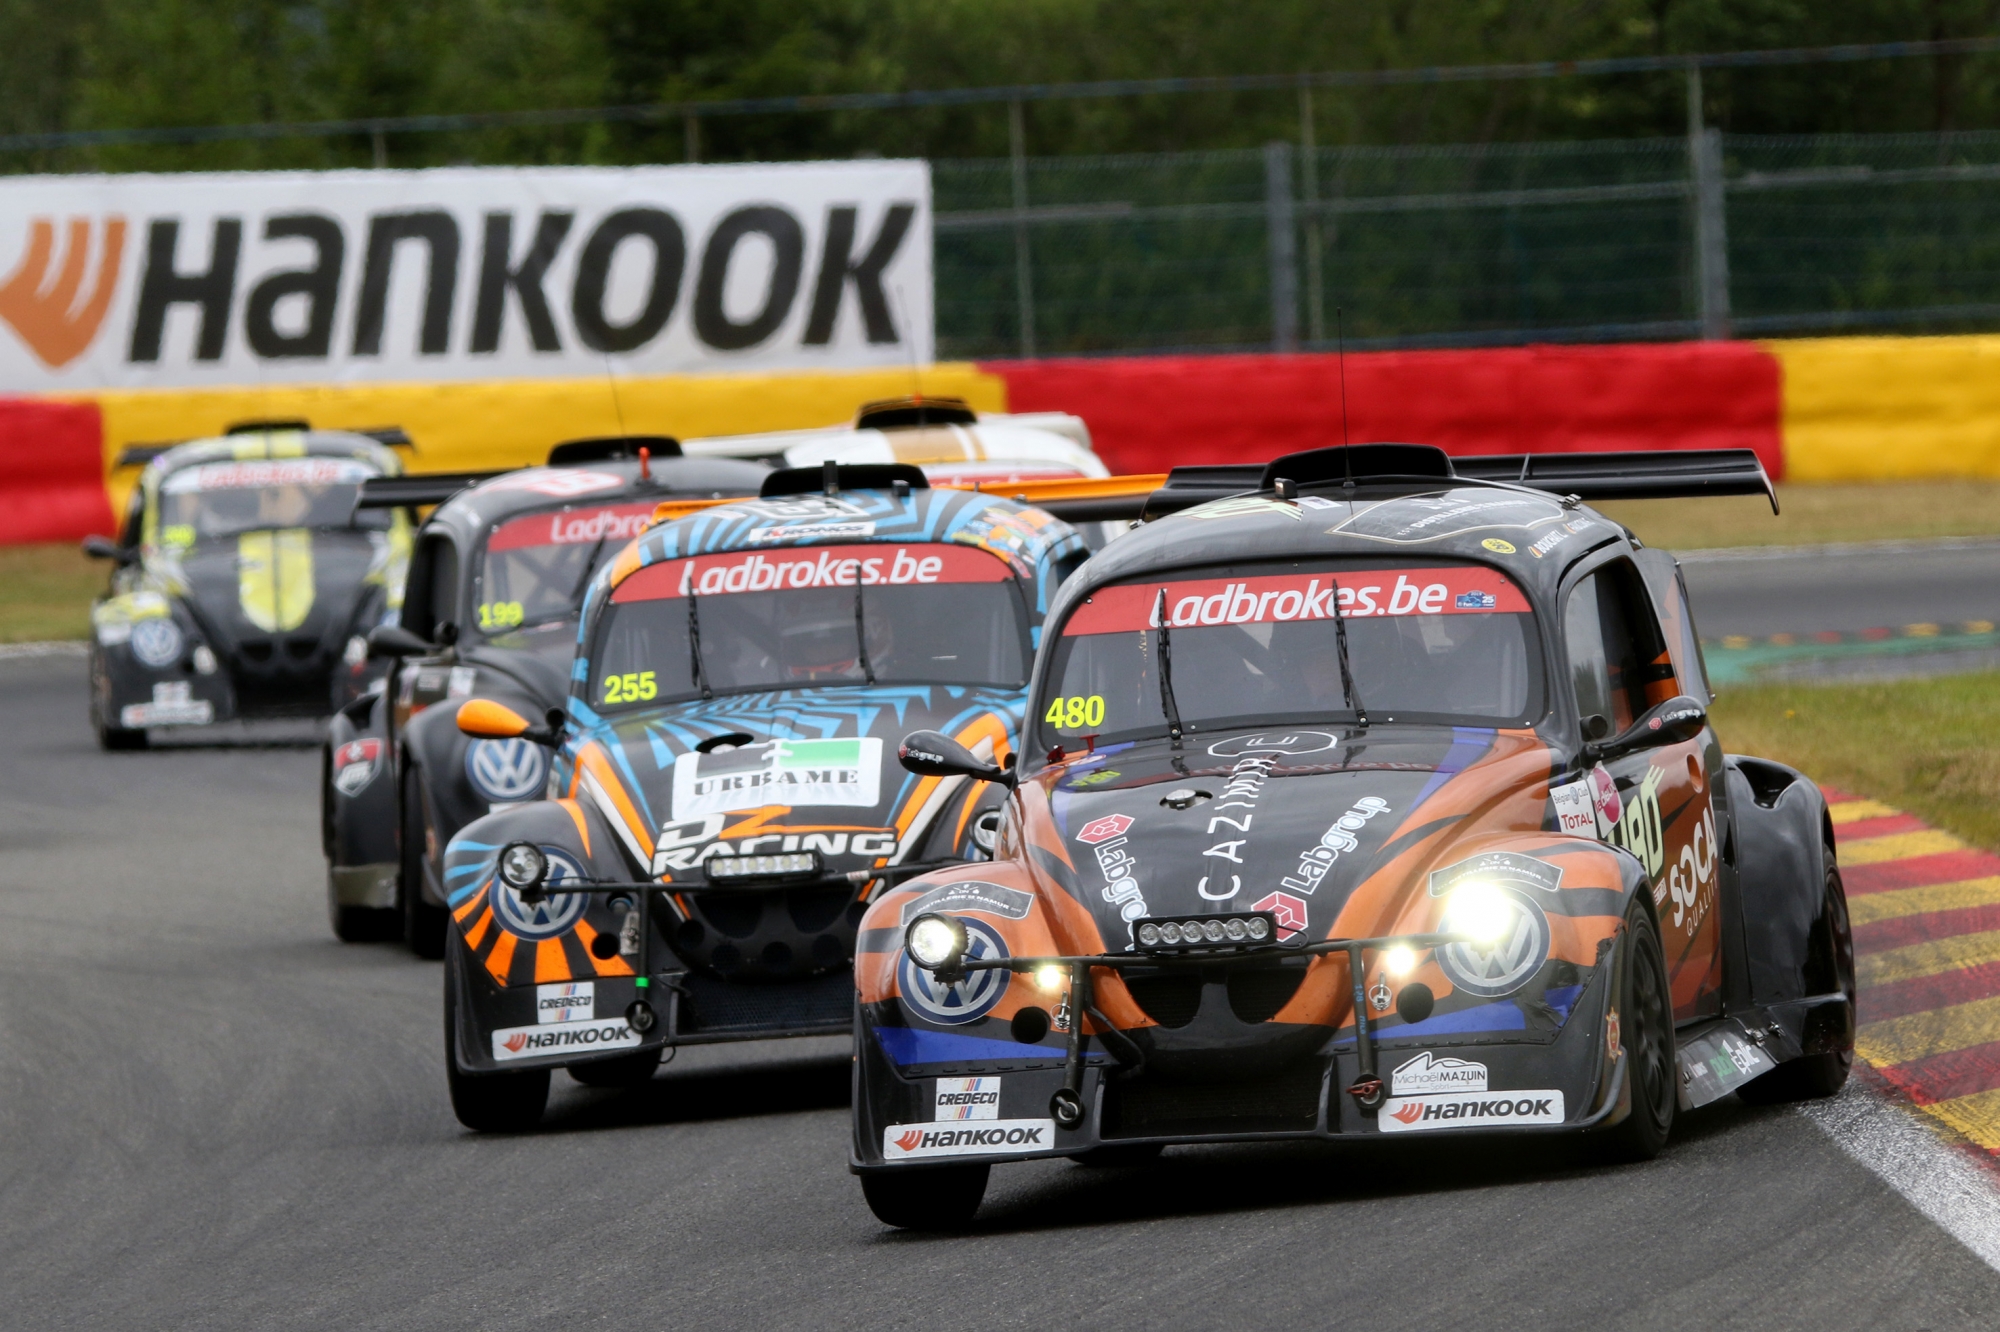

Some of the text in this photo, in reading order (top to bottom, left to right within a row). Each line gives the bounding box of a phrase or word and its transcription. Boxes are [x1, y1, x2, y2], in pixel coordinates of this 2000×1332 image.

[551, 512, 650, 544] Ladbro
[678, 549, 942, 596] Ladbrokes.be
[478, 601, 523, 628] 199
[1149, 575, 1448, 628] Ladbrokes.be
[604, 671, 658, 704] 255
[1045, 695, 1105, 729] 480
[694, 769, 860, 796] URBAME
[1561, 811, 1594, 831] TOTAL
[1280, 796, 1392, 895] Labgroup
[976, 894, 1010, 910] NAMUR
[1094, 836, 1151, 951] Labgro
[539, 995, 593, 1010] CREDECO
[937, 1092, 998, 1106] CREDECO
